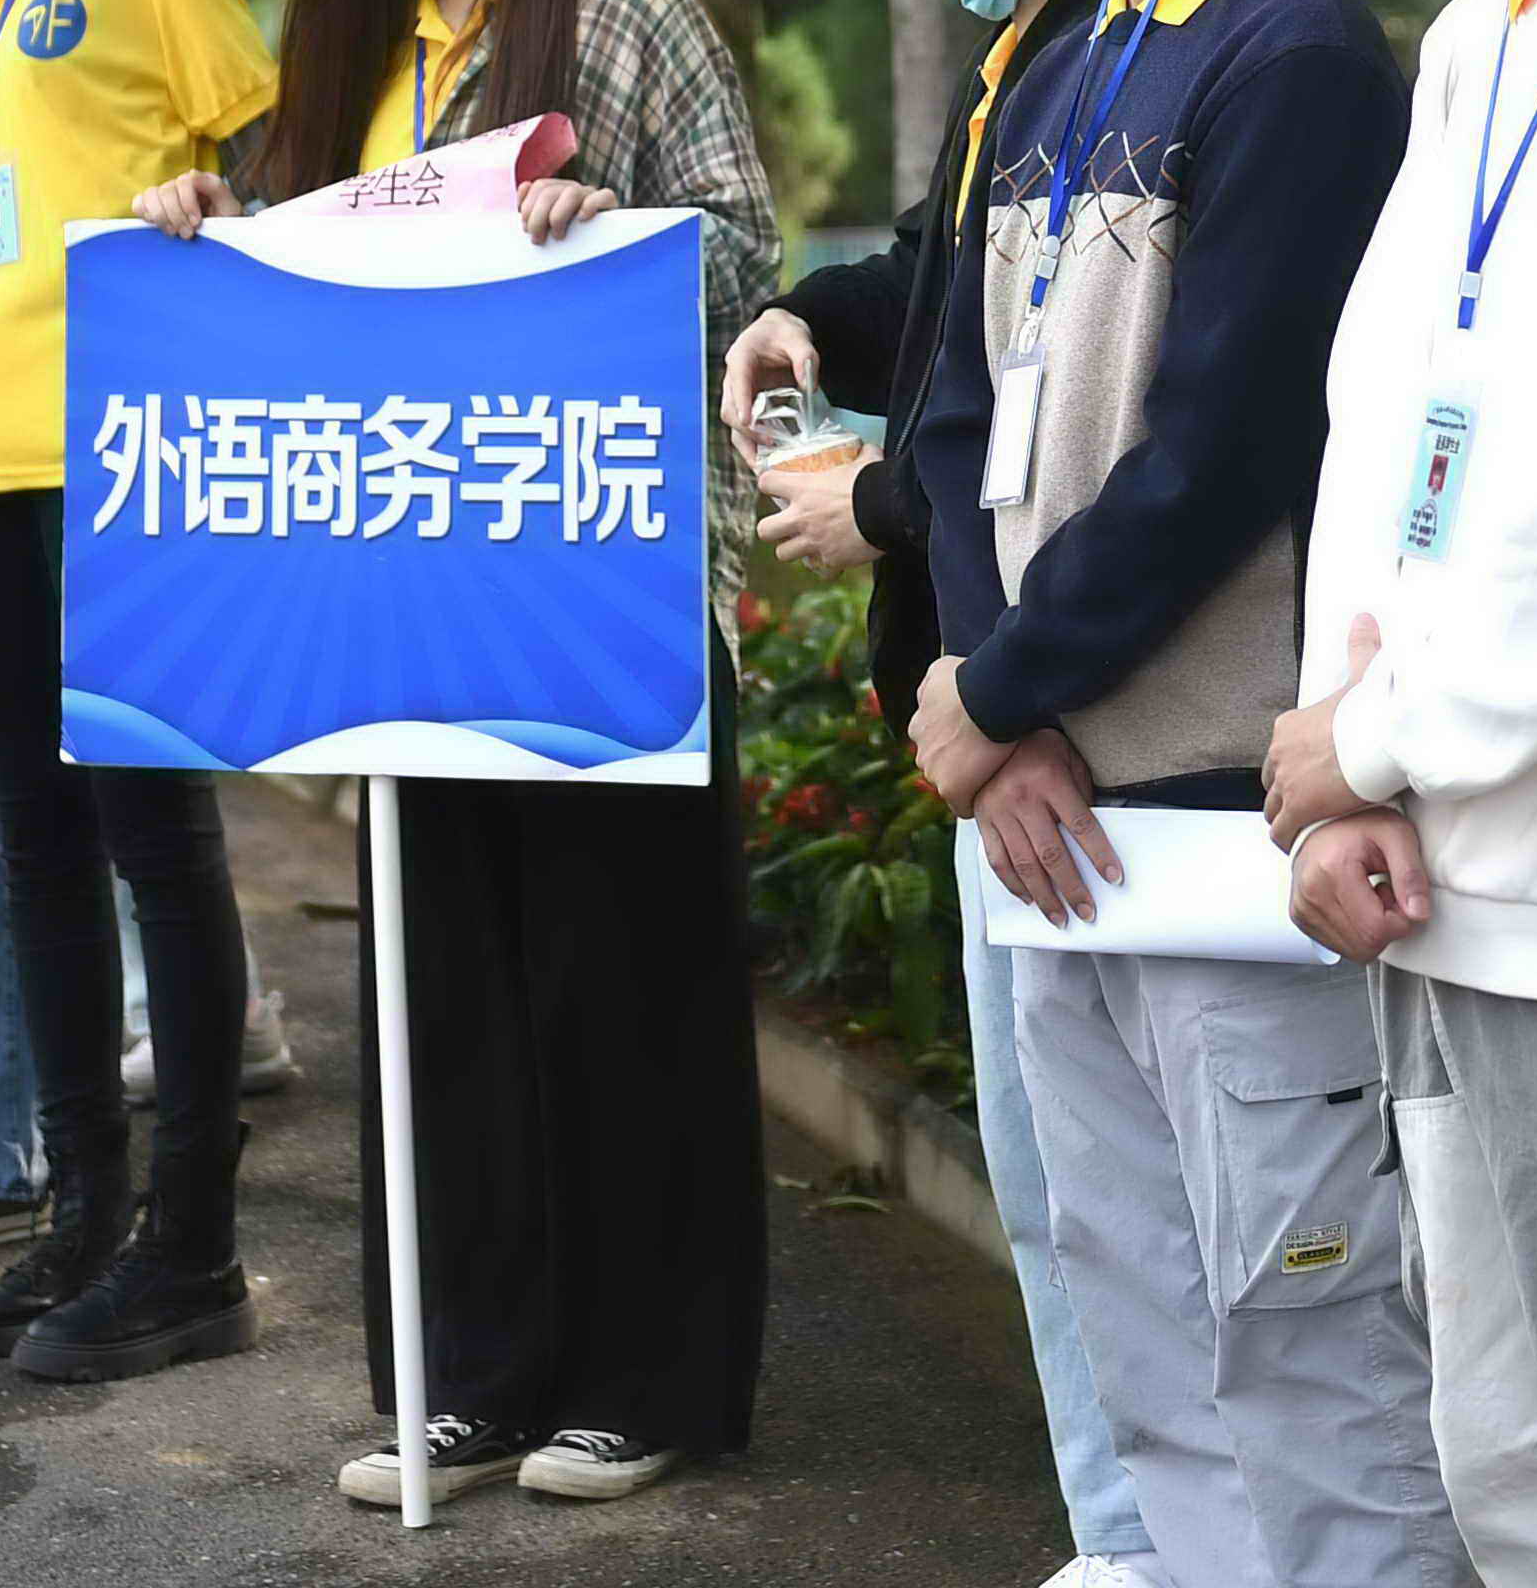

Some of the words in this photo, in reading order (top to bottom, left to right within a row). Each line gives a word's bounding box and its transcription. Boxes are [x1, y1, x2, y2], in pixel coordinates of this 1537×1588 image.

[338, 159, 445, 210] 学生会
[93, 393, 666, 543] 外语商务学院
